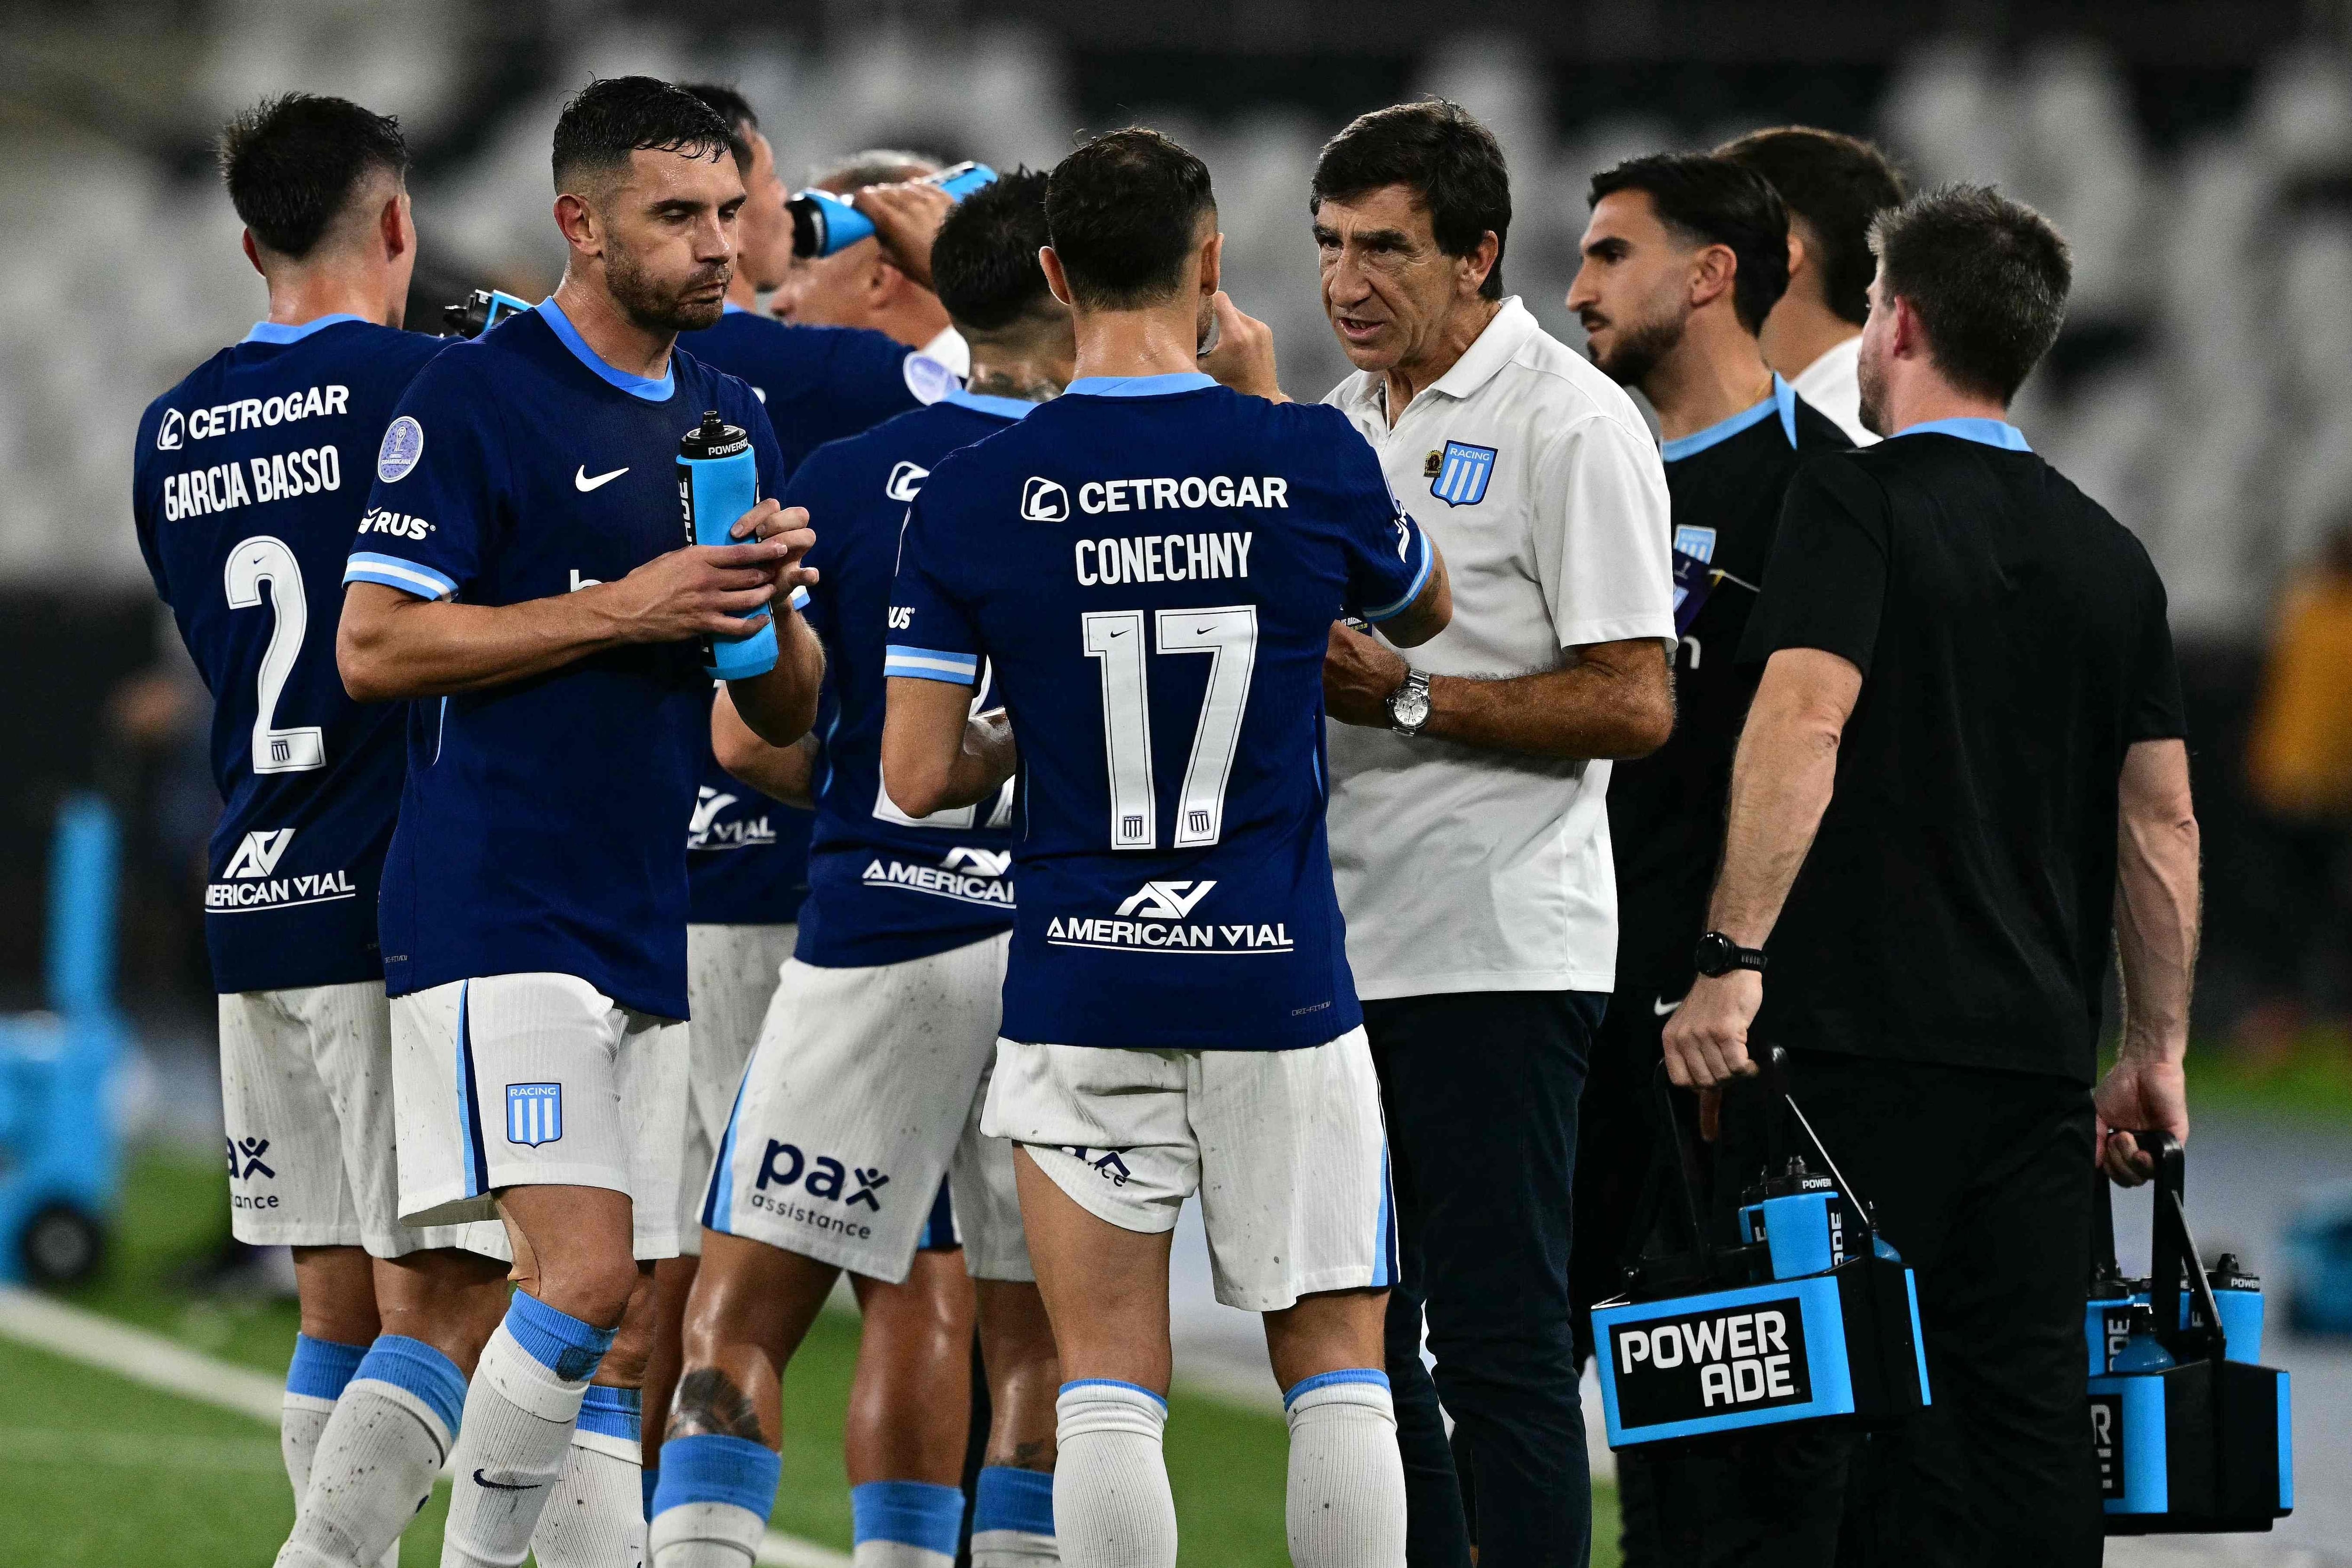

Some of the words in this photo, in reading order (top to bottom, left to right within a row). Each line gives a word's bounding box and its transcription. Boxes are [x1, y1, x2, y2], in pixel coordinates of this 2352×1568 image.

[189, 386, 349, 440] CETROGAR
[1450, 447, 1490, 461] RACING
[165, 461, 251, 522] GARCIA
[251, 445, 341, 503] BASSO
[1079, 476, 1289, 514] CETROGAR
[1075, 532, 1252, 586] CONECHNY
[224, 535, 326, 774] 2
[1081, 605, 1258, 850] 17
[293, 870, 356, 897] VIAL
[1047, 917, 1213, 947] AMERICAN
[1219, 923, 1294, 947] VIAL
[510, 1087, 556, 1097] RACING
[752, 1194, 871, 1239] assistance
[1619, 1311, 1789, 1374] POWER
[1701, 1354, 1795, 1407] ADE
